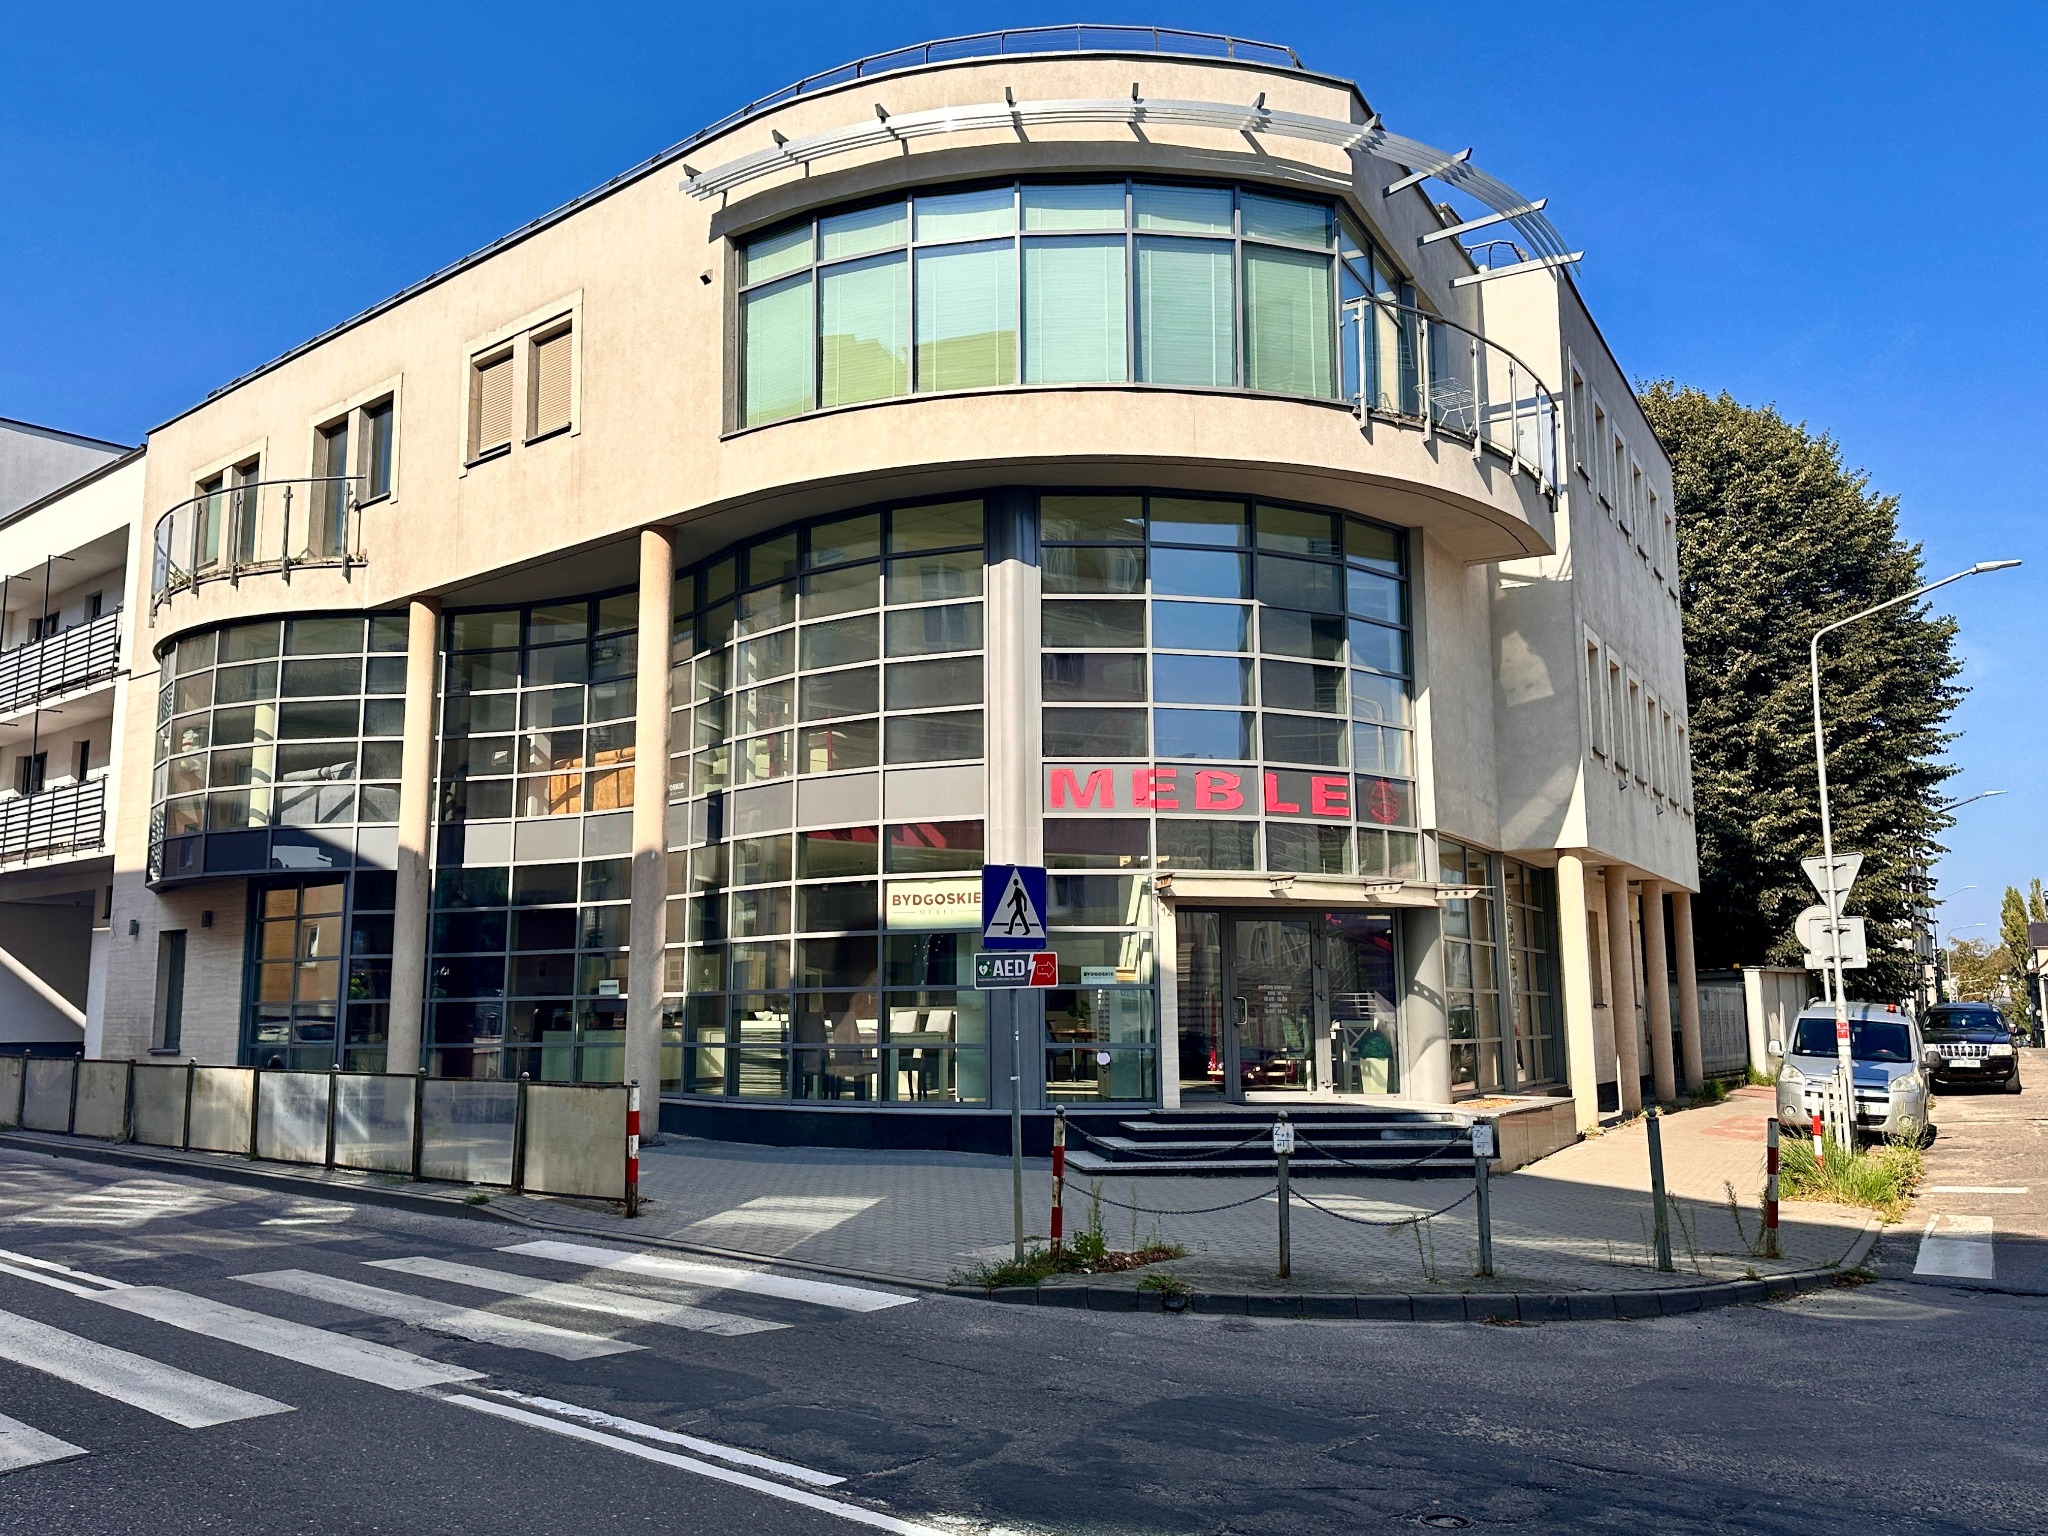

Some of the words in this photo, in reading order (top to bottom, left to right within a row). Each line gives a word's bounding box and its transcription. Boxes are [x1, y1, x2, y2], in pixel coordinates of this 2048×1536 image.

[1050, 768, 1349, 816] MEBLE
[892, 892, 981, 906] BYDGOSKIE
[993, 960, 1025, 976] AED
